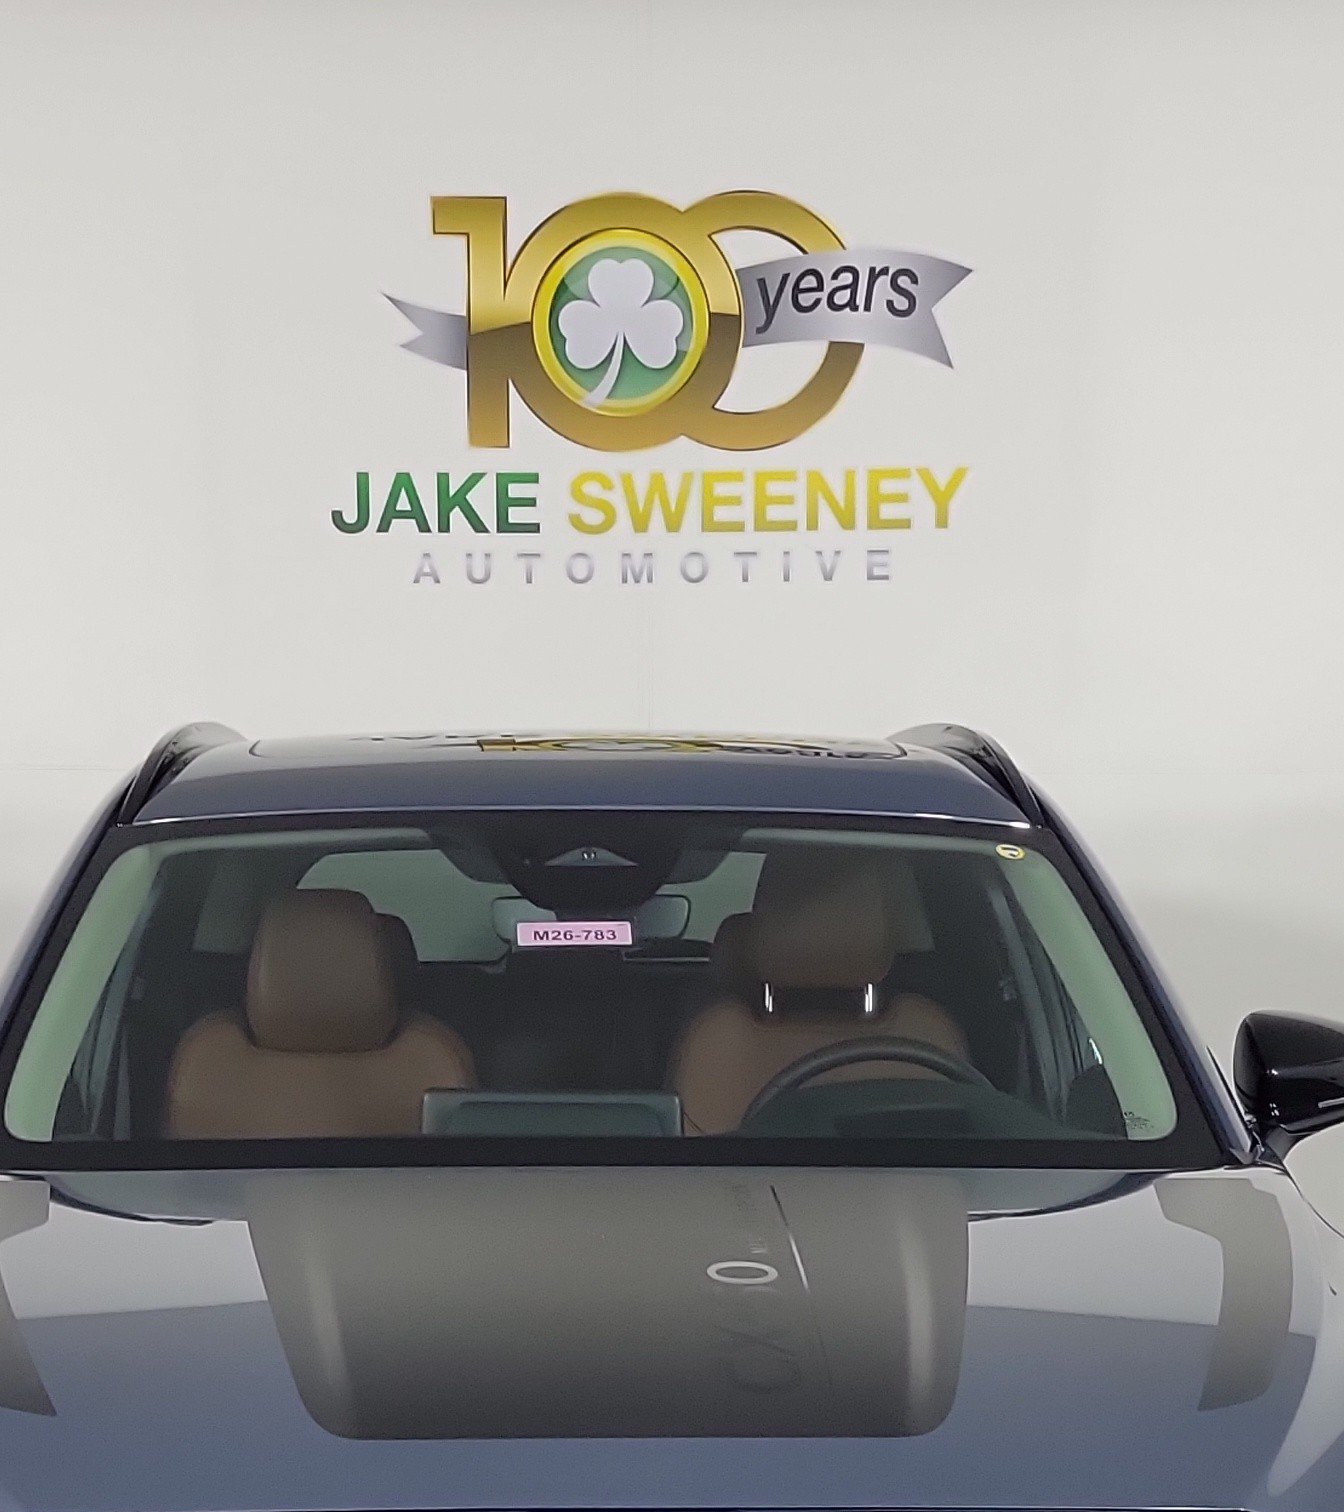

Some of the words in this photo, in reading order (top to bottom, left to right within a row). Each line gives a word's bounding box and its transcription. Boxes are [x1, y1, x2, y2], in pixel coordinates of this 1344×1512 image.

[430, 190, 865, 452] 100
[755, 265, 918, 334] years
[331, 471, 541, 535] JAKE
[567, 466, 969, 534] SWEENEY
[413, 549, 891, 585] AUTOMOTIVE
[533, 929, 617, 941] M26-783
